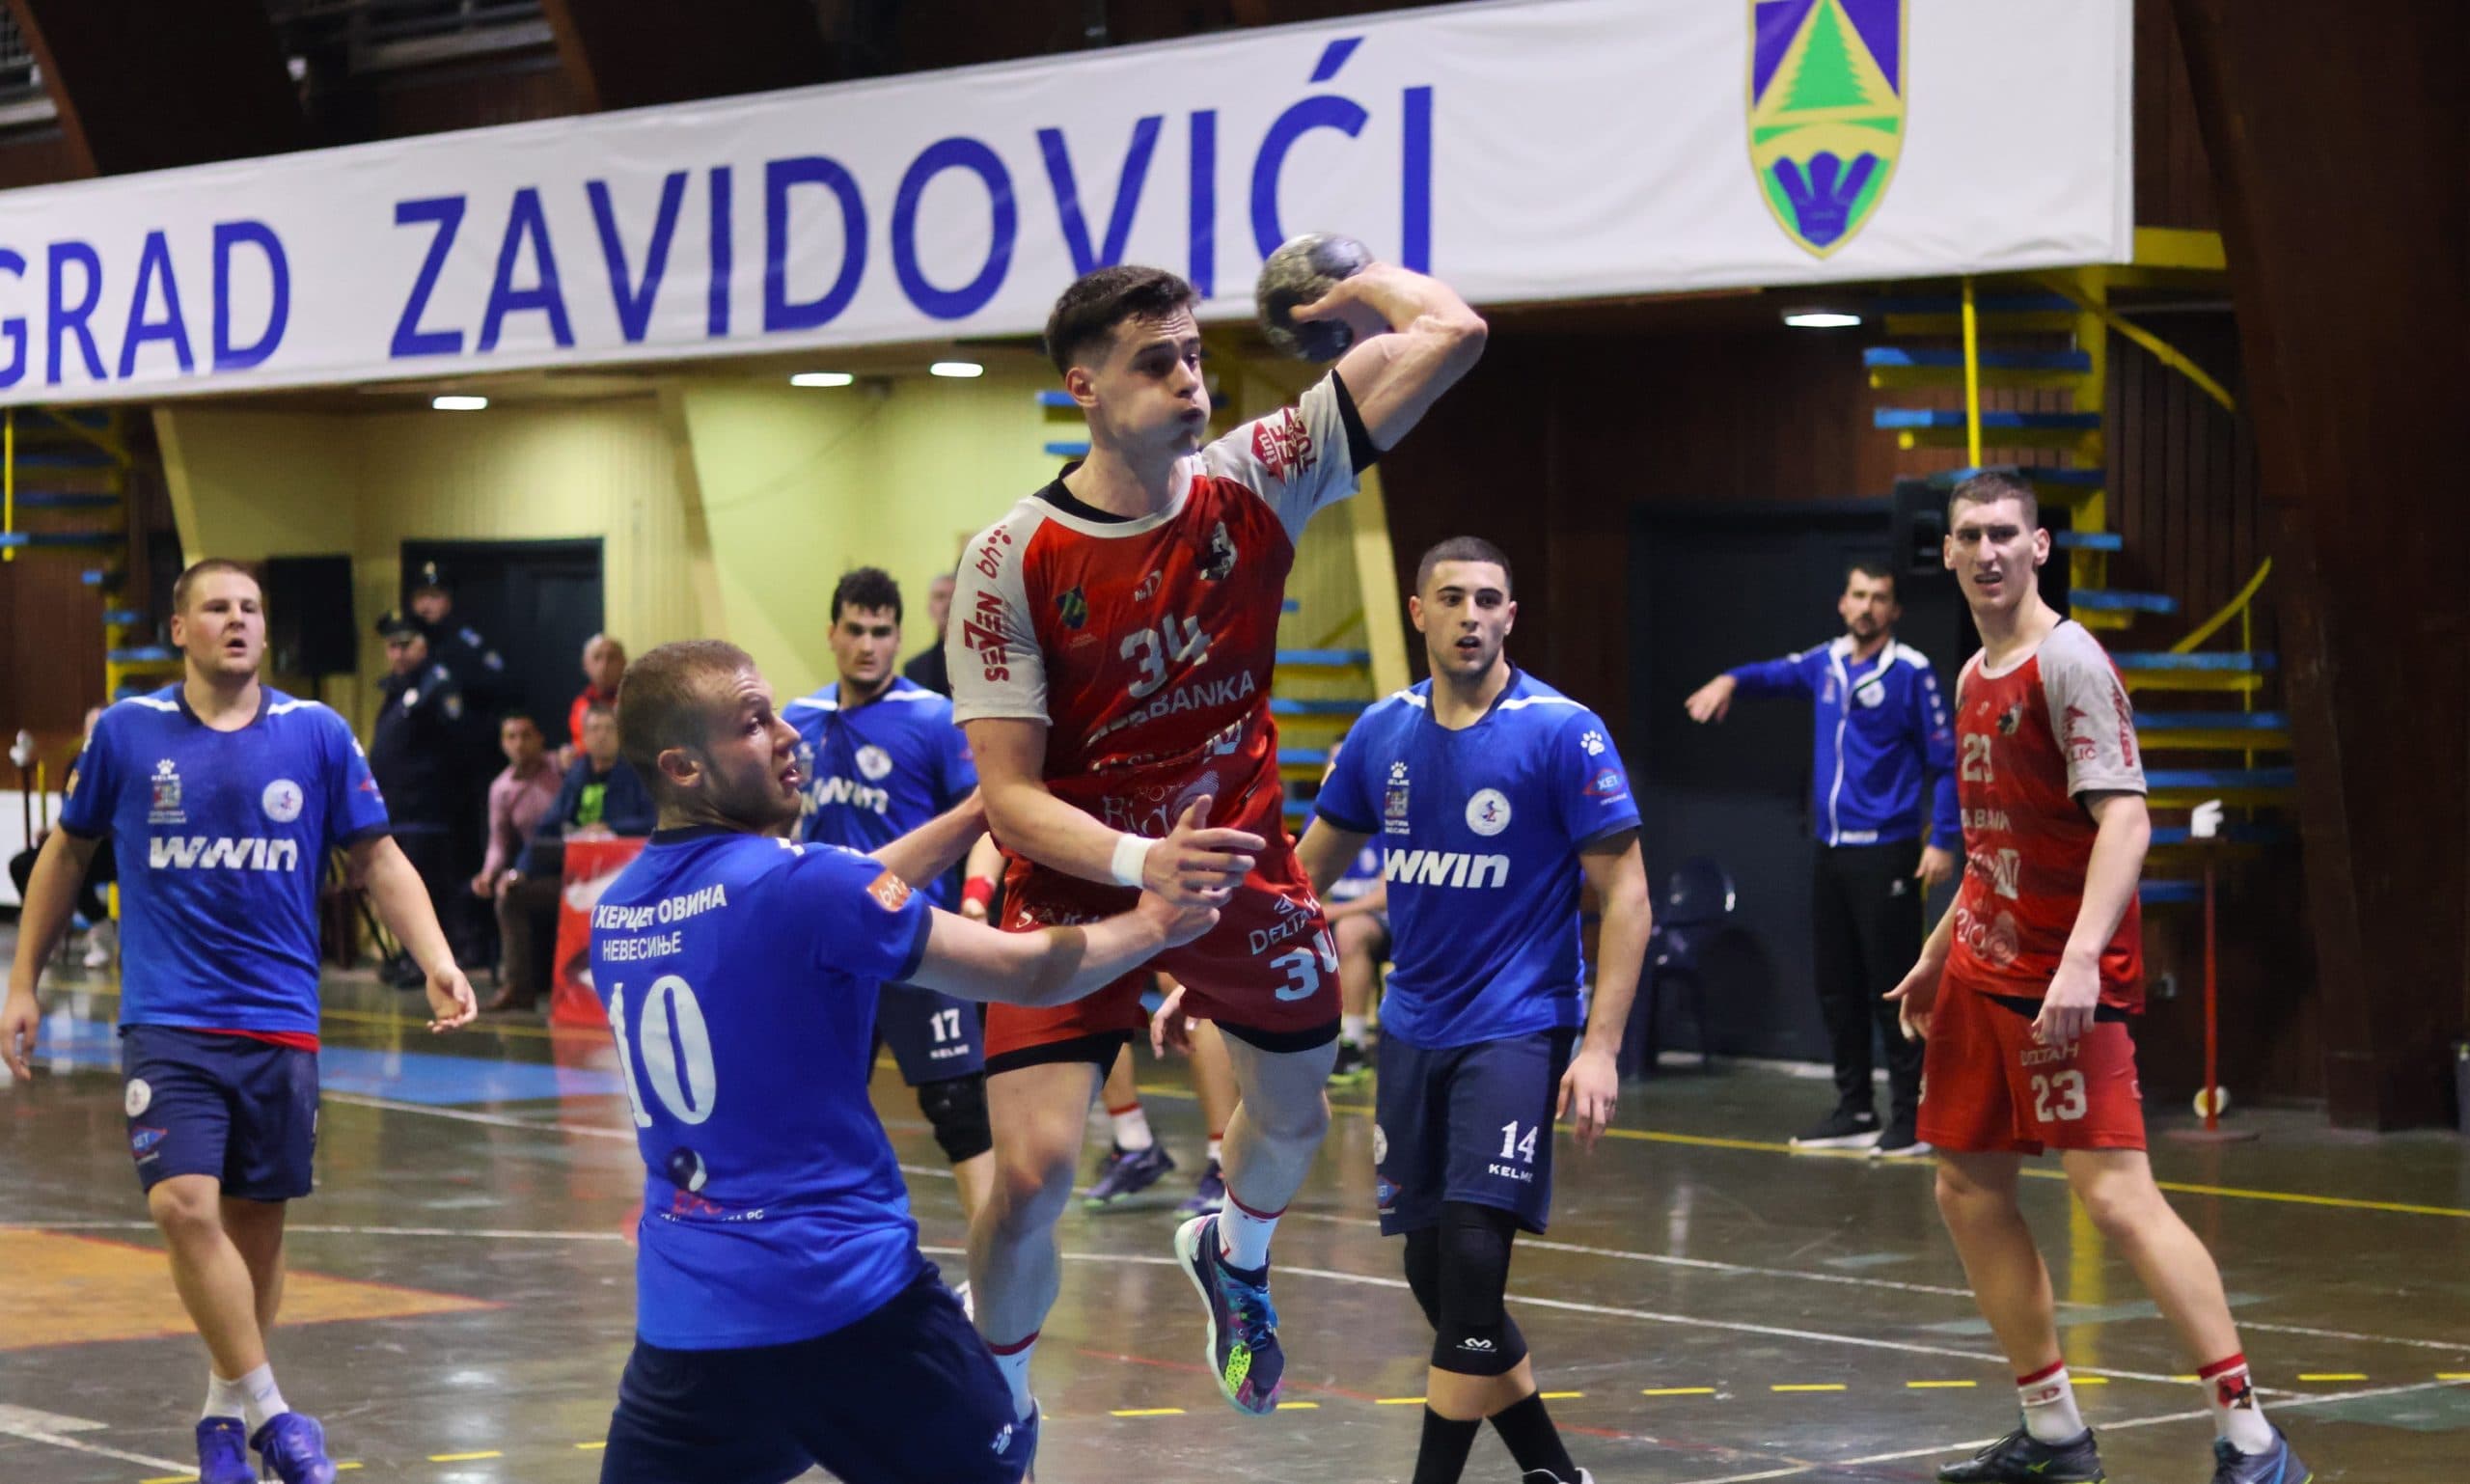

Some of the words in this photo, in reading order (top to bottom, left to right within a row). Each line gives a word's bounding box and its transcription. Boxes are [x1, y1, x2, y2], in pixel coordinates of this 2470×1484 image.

[388, 37, 1434, 358] ZAVIDOVIĆI
[1118, 614, 1212, 696] 34
[602, 930, 683, 962] НЕВЕСИЊЕ
[608, 975, 717, 1128] 10
[929, 1008, 962, 1043] 17
[2030, 1069, 2088, 1122] 23
[1498, 1119, 1539, 1165] 14
